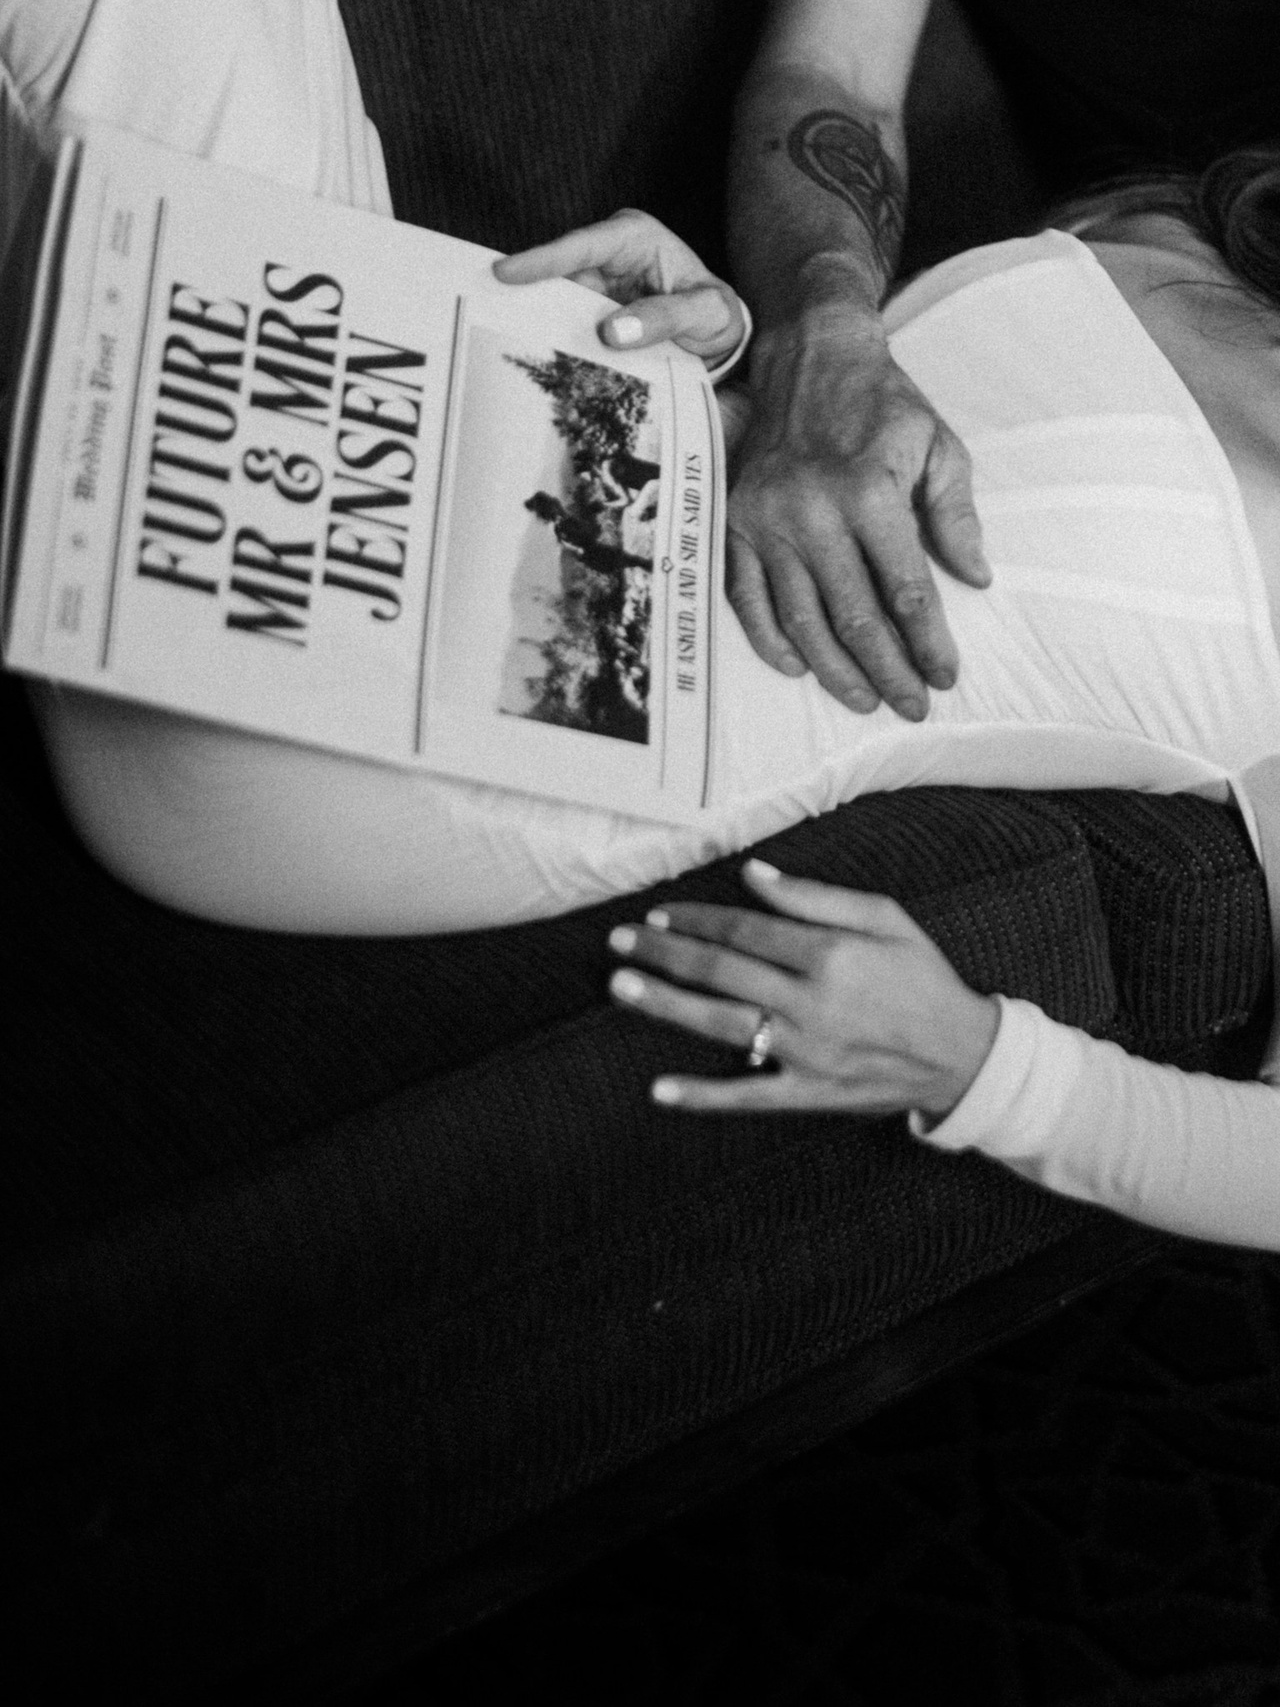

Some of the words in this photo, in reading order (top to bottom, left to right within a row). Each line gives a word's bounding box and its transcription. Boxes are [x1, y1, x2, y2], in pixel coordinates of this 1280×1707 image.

[249, 261, 345, 426] MRS
[137, 282, 251, 595] FUTURE
[243, 447, 324, 505] &
[322, 332, 428, 622] JENSEN
[685, 453, 702, 481] YES
[683, 487, 701, 527] SAID
[681, 530, 699, 564] SHE
[226, 527, 316, 648] MR
[679, 567, 697, 601] AND
[677, 669, 697, 692] HE
